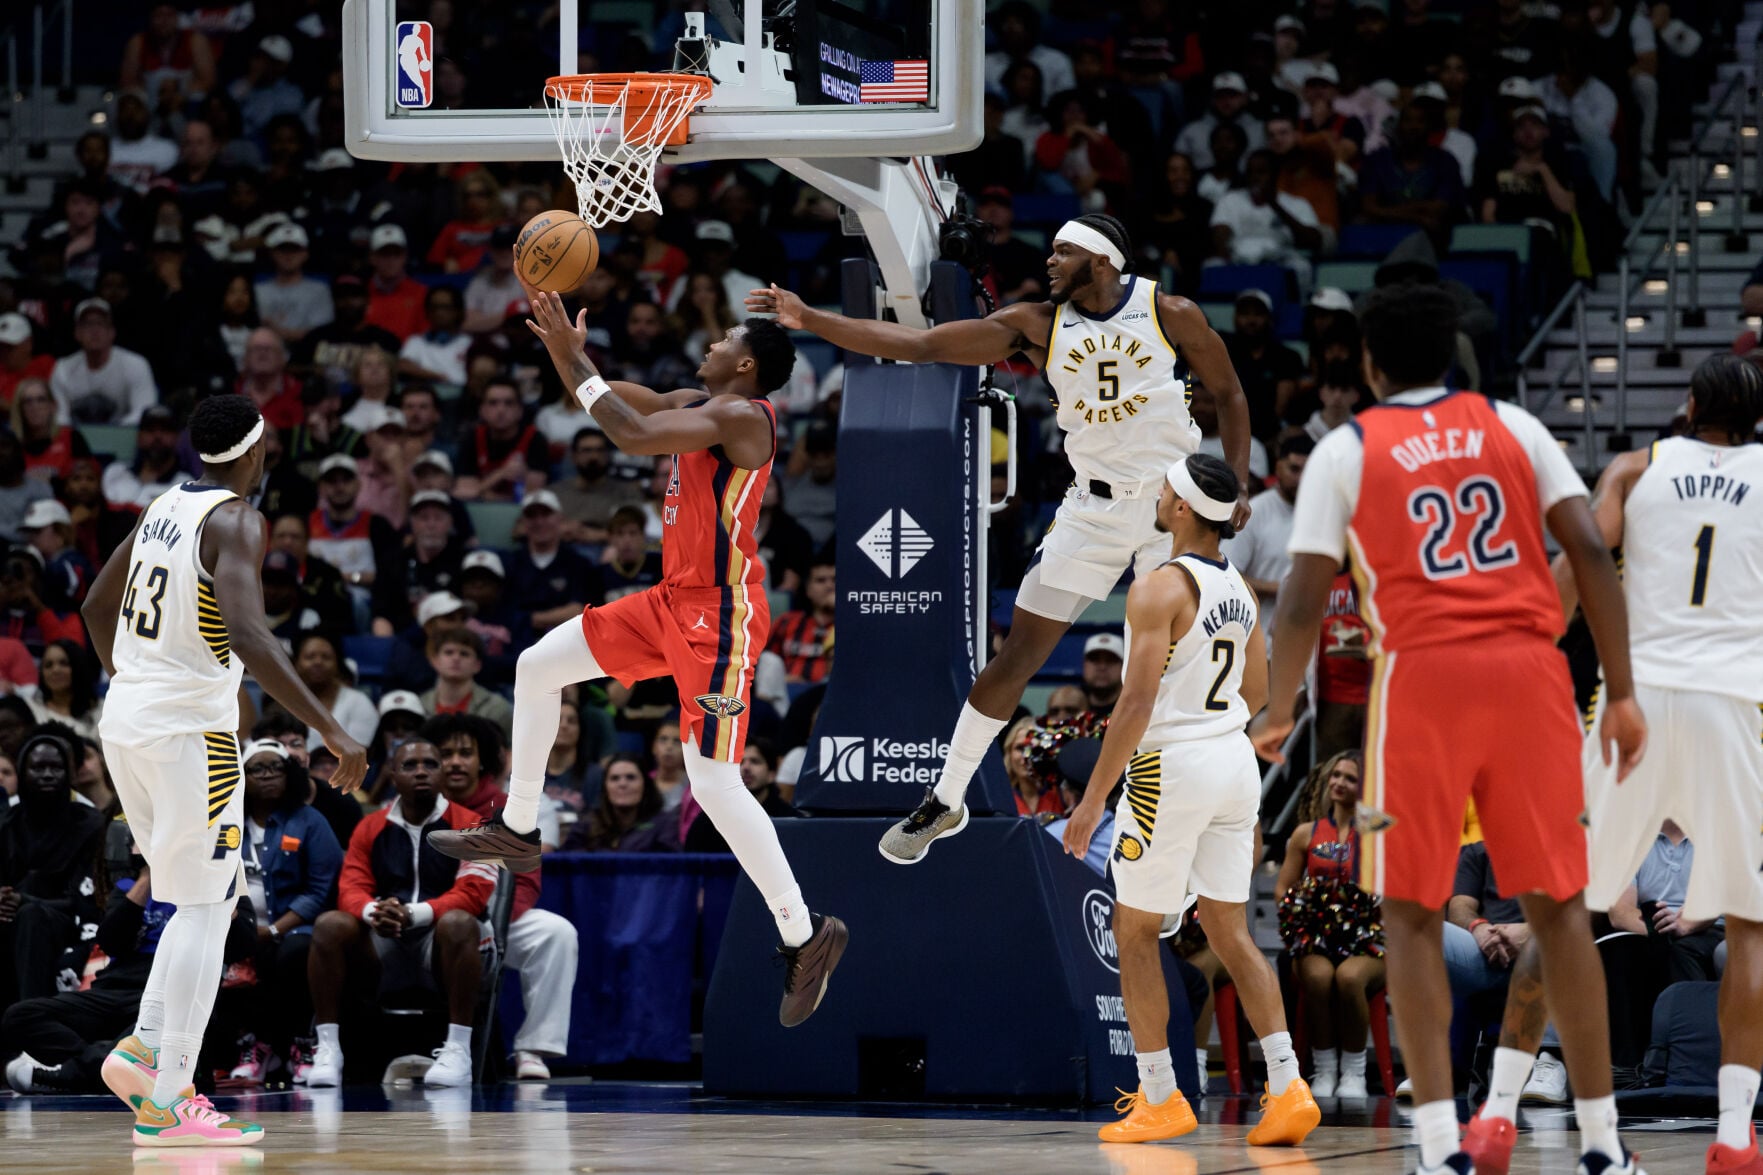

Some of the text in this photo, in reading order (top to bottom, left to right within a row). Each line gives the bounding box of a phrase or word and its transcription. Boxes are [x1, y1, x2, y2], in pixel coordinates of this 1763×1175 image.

[820, 41, 847, 70] GRILLING
[401, 88, 419, 102] NBA
[821, 72, 861, 105] NEWAGEPRO
[1063, 334, 1153, 374] INDIANA
[1097, 360, 1120, 402] 5
[1074, 394, 1149, 424] PACERS
[1391, 428, 1484, 473] QUEEN
[1671, 464, 1750, 506] TOPPIN
[142, 518, 182, 552] SIAKAM
[1407, 474, 1520, 581] 22
[1689, 523, 1716, 608] 1
[122, 560, 169, 640] 43
[848, 591, 942, 602] AMERICAN
[860, 603, 929, 614] SAFETY
[1205, 638, 1235, 711] 2
[872, 737, 951, 759] Keesle
[872, 761, 942, 783] Feder
[1096, 994, 1128, 1022] SOUTHE
